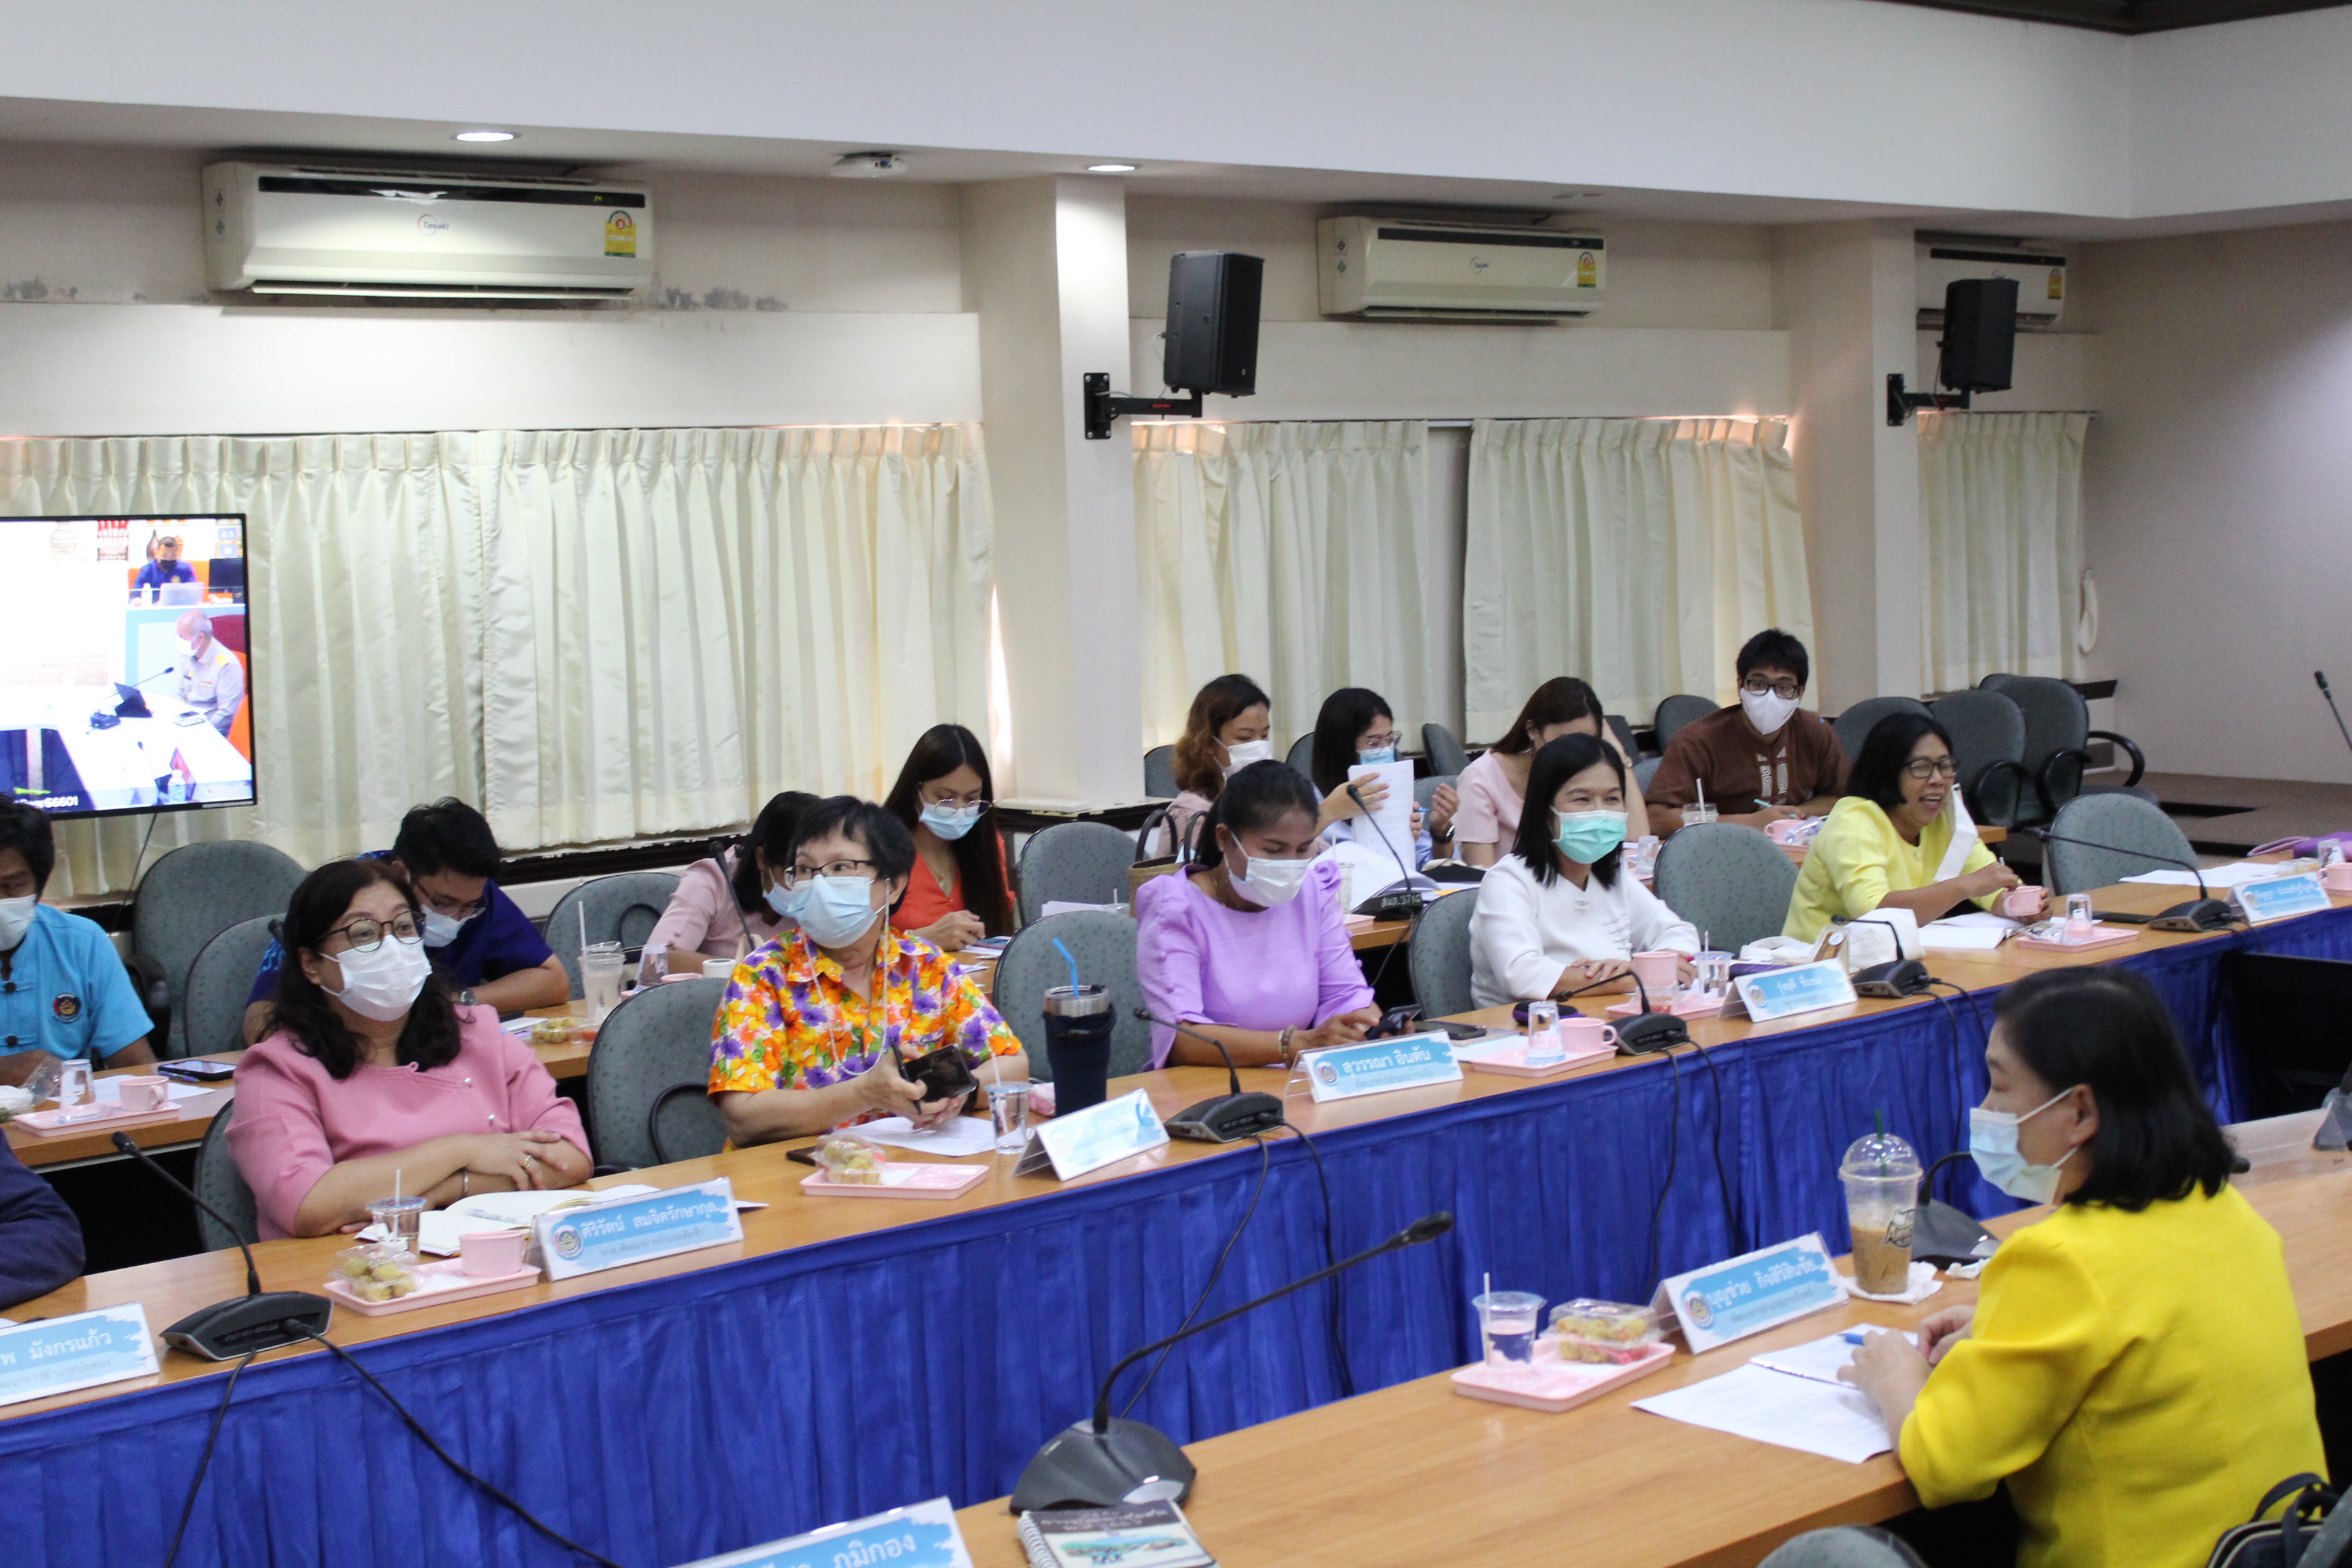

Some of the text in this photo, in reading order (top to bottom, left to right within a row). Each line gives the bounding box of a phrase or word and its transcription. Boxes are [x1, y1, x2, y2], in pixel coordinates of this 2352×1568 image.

[1342, 1056, 1394, 1077] สุวรรณา
[581, 1214, 625, 1239] ศิริรัตน์
[28, 1328, 112, 1360] มังกรแก้ว
[833, 1533, 917, 1568] ภมิกอง
